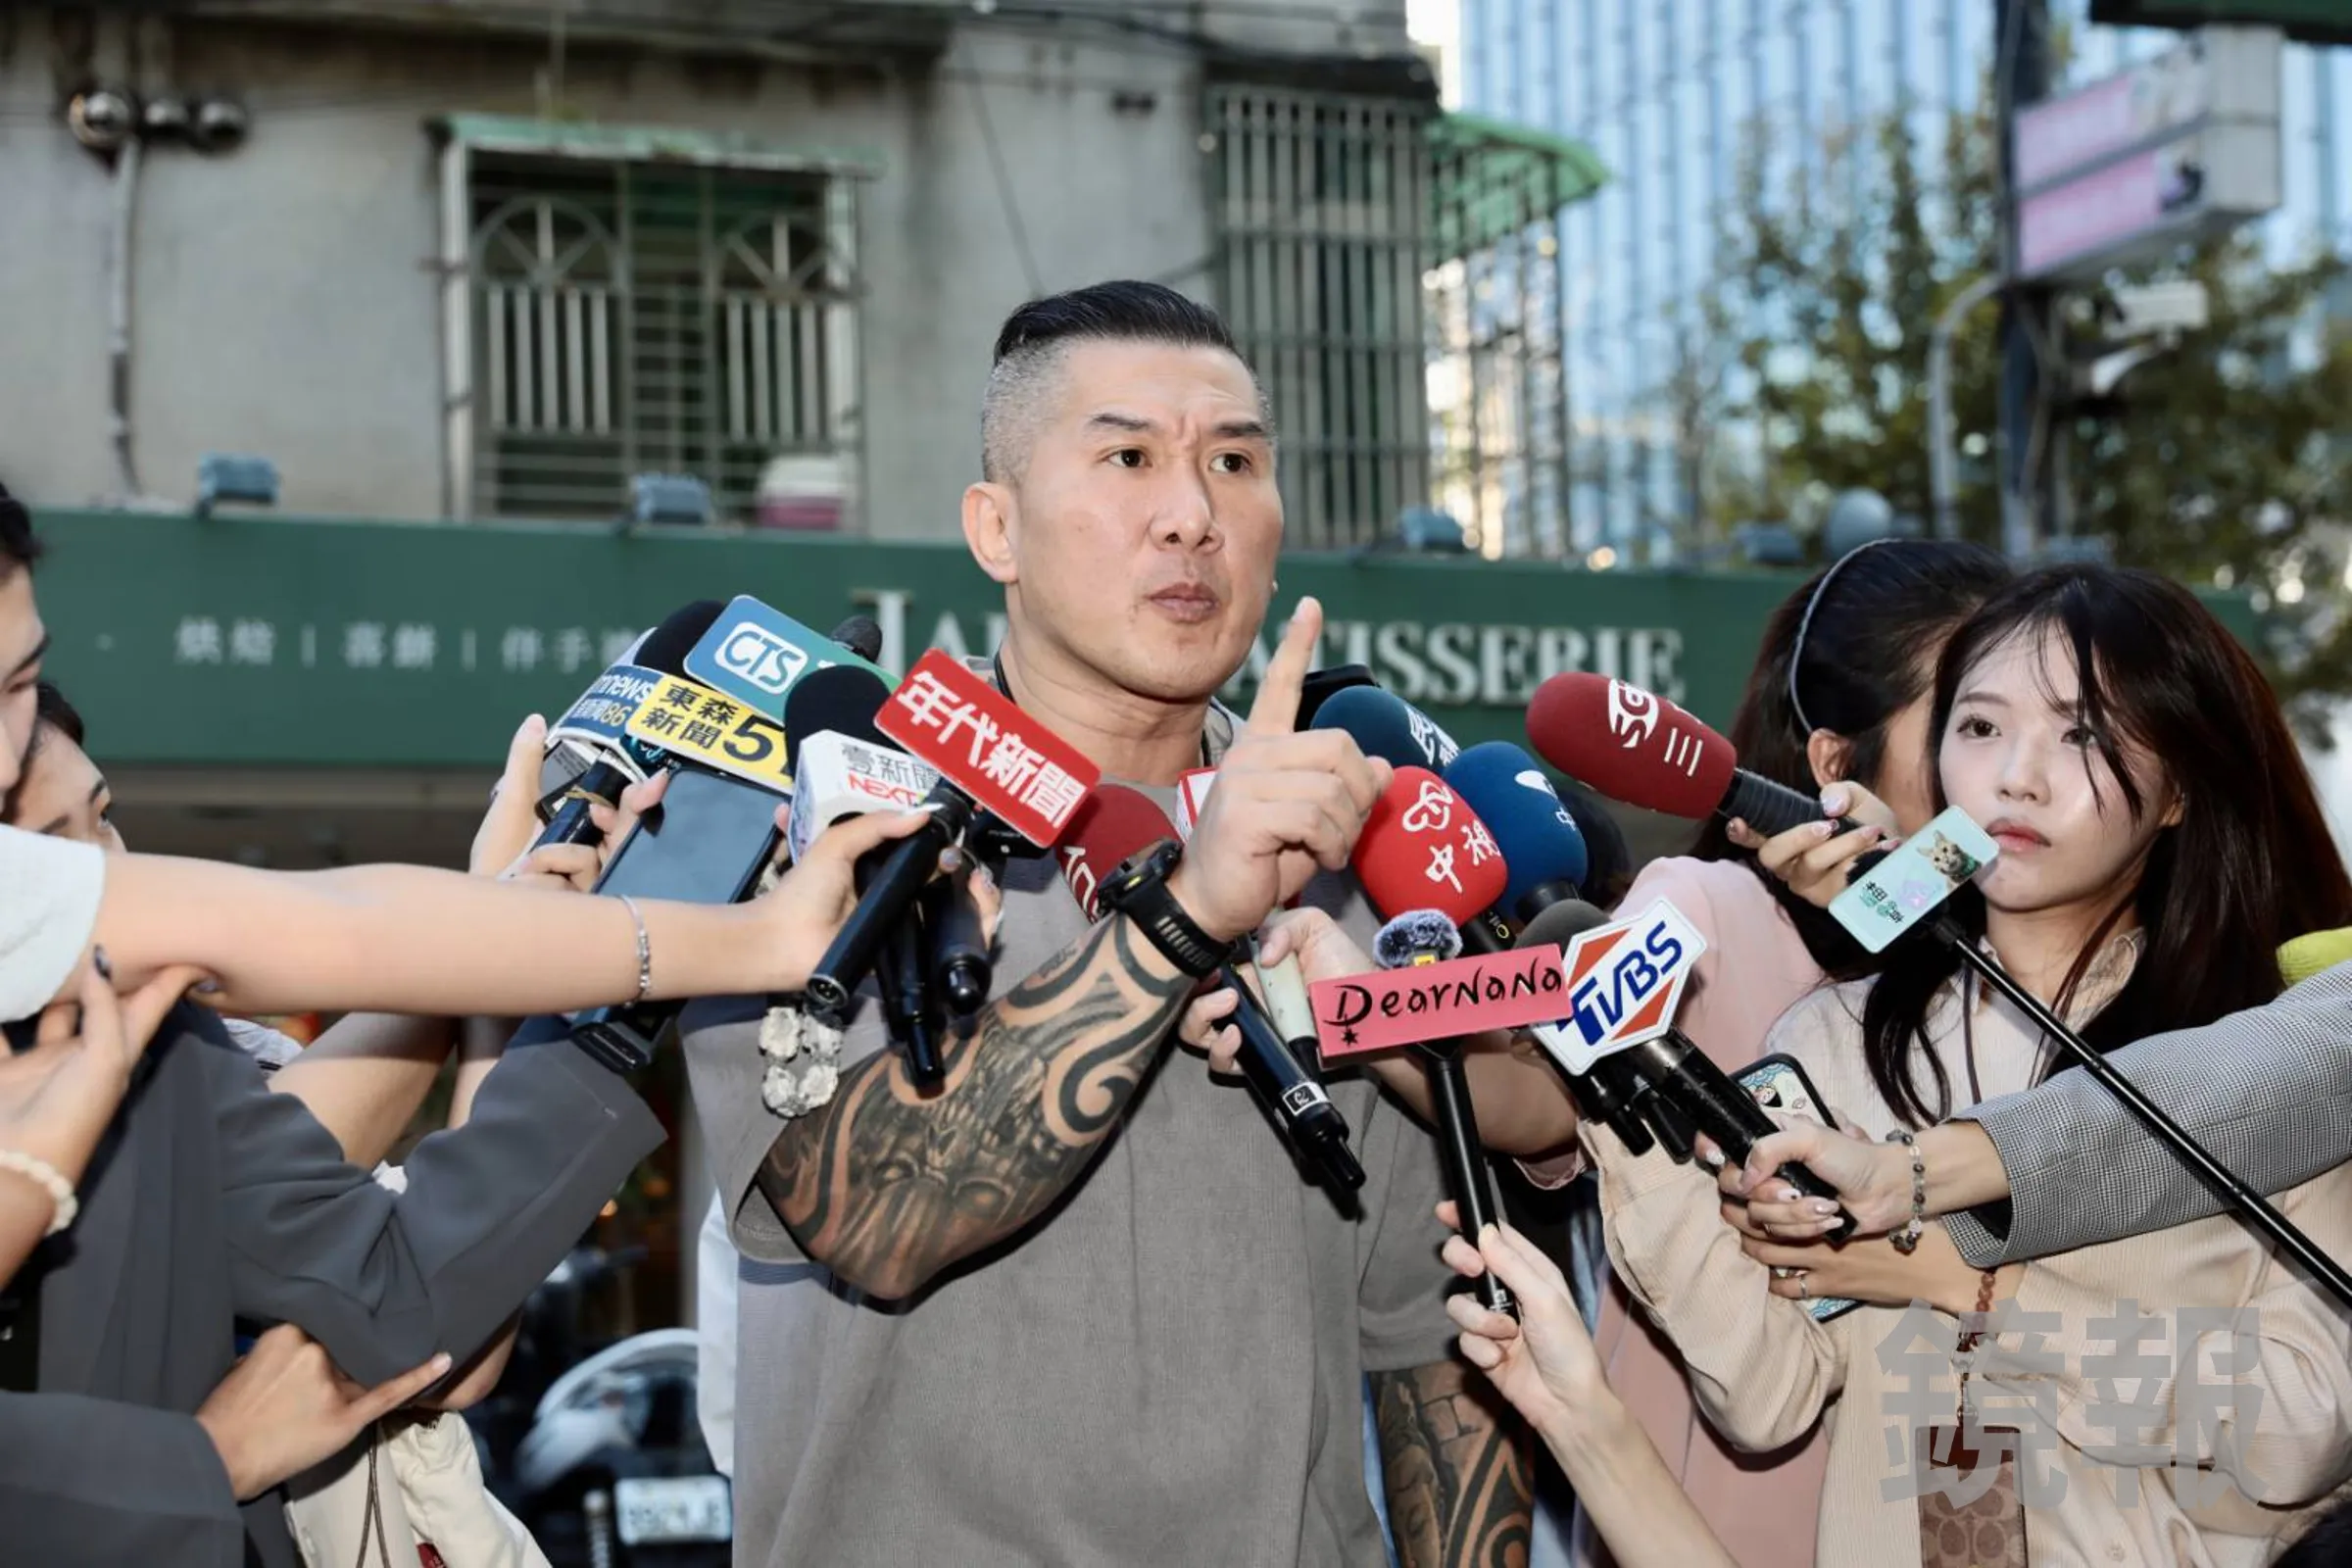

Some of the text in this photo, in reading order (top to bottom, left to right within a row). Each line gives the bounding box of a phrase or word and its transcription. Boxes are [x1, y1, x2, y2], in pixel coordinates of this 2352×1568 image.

[723, 629, 802, 687] CTS
[641, 707, 723, 750] 新聞
[659, 682, 740, 725] 東森
[897, 670, 1087, 829] 年代新聞
[1425, 818, 1502, 894] 中視
[1556, 919, 1684, 1047] TVBS
